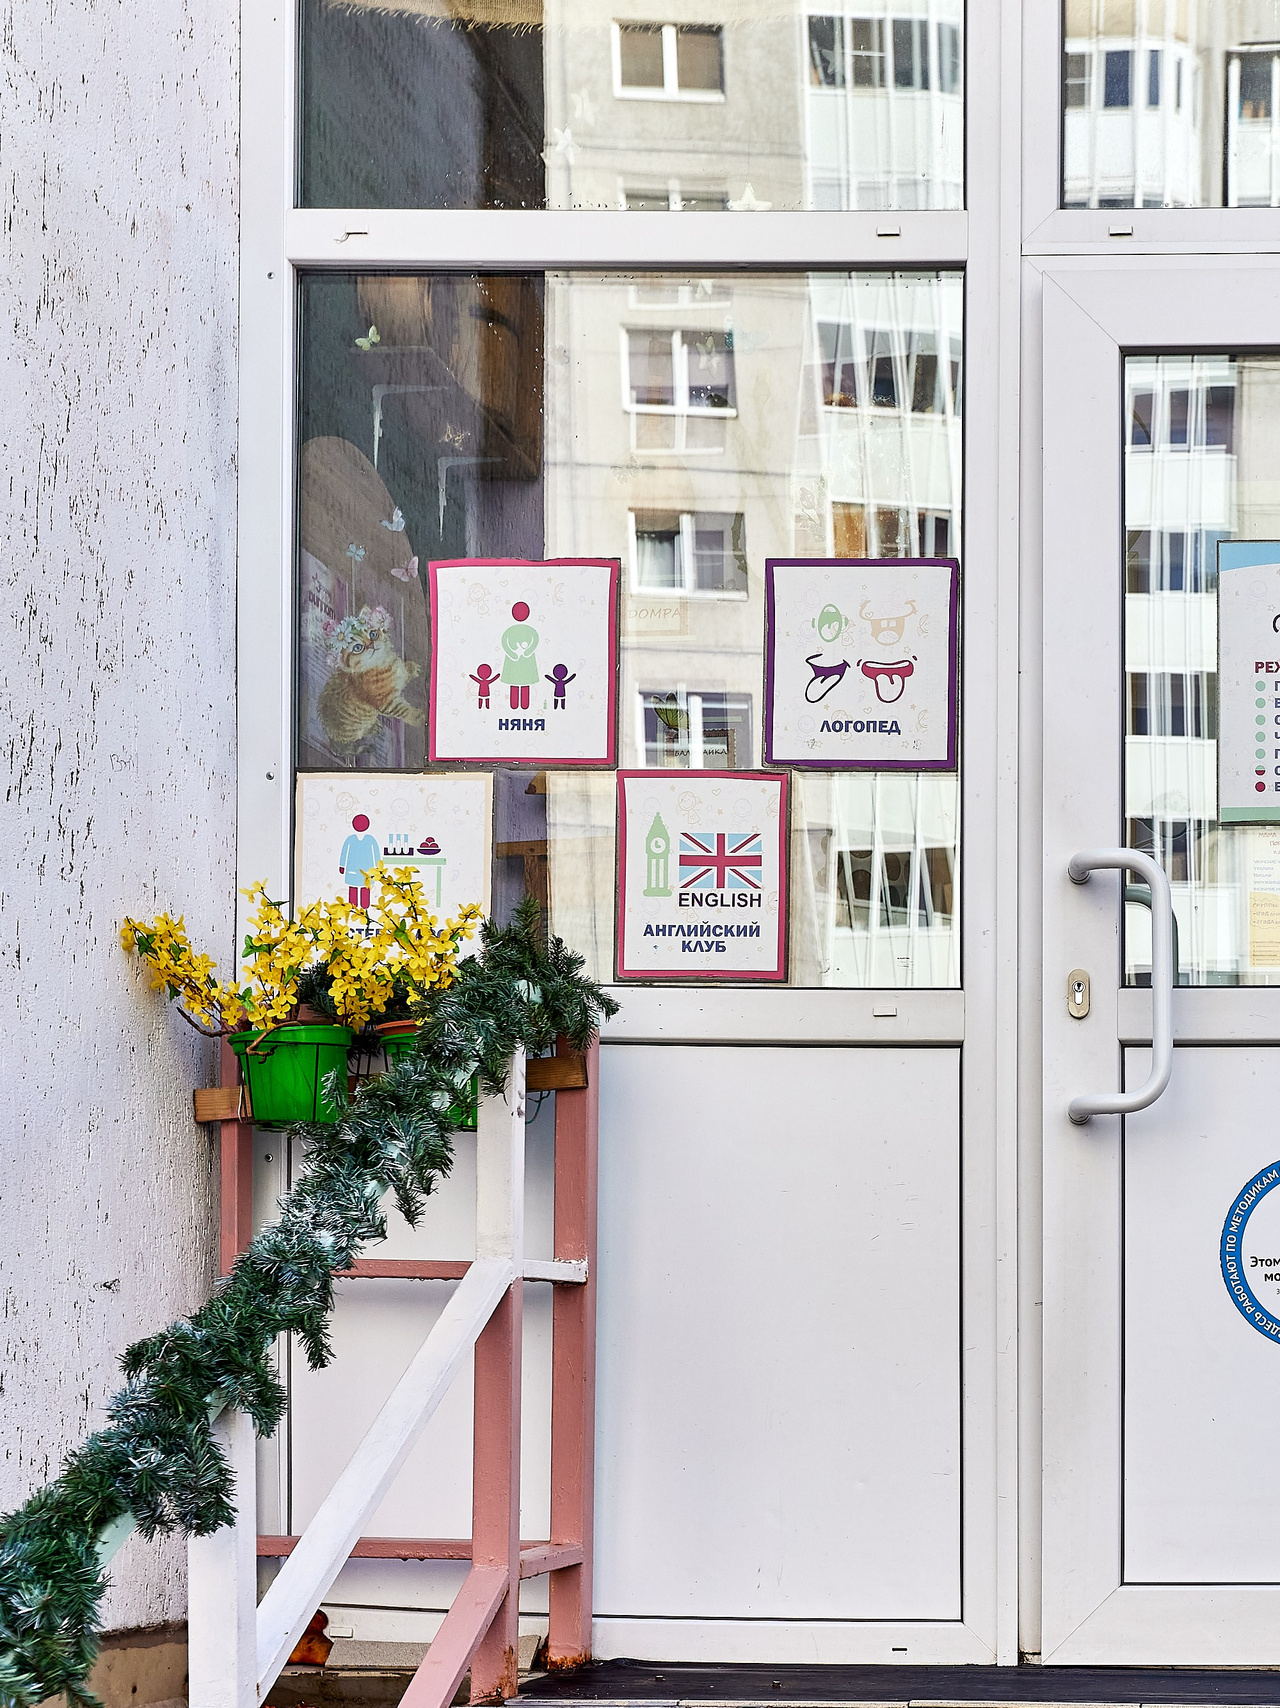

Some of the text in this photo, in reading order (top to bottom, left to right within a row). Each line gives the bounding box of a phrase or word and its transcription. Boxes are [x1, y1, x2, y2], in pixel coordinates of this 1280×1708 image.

[498, 718, 546, 732] НЯНЯ
[819, 719, 902, 736] ЛОГОПЕД
[674, 749, 727, 757] БАЛАЙКА
[678, 892, 762, 908] ENGLISH
[642, 920, 761, 938] АНГЛИЙСКИЙ
[681, 940, 727, 954] КЛУБ
[1229, 1169, 1279, 1232] МЕТОДИКАМ
[1226, 1234, 1237, 1252] ПО
[1226, 1255, 1256, 1314] РАБОТАЮТ
